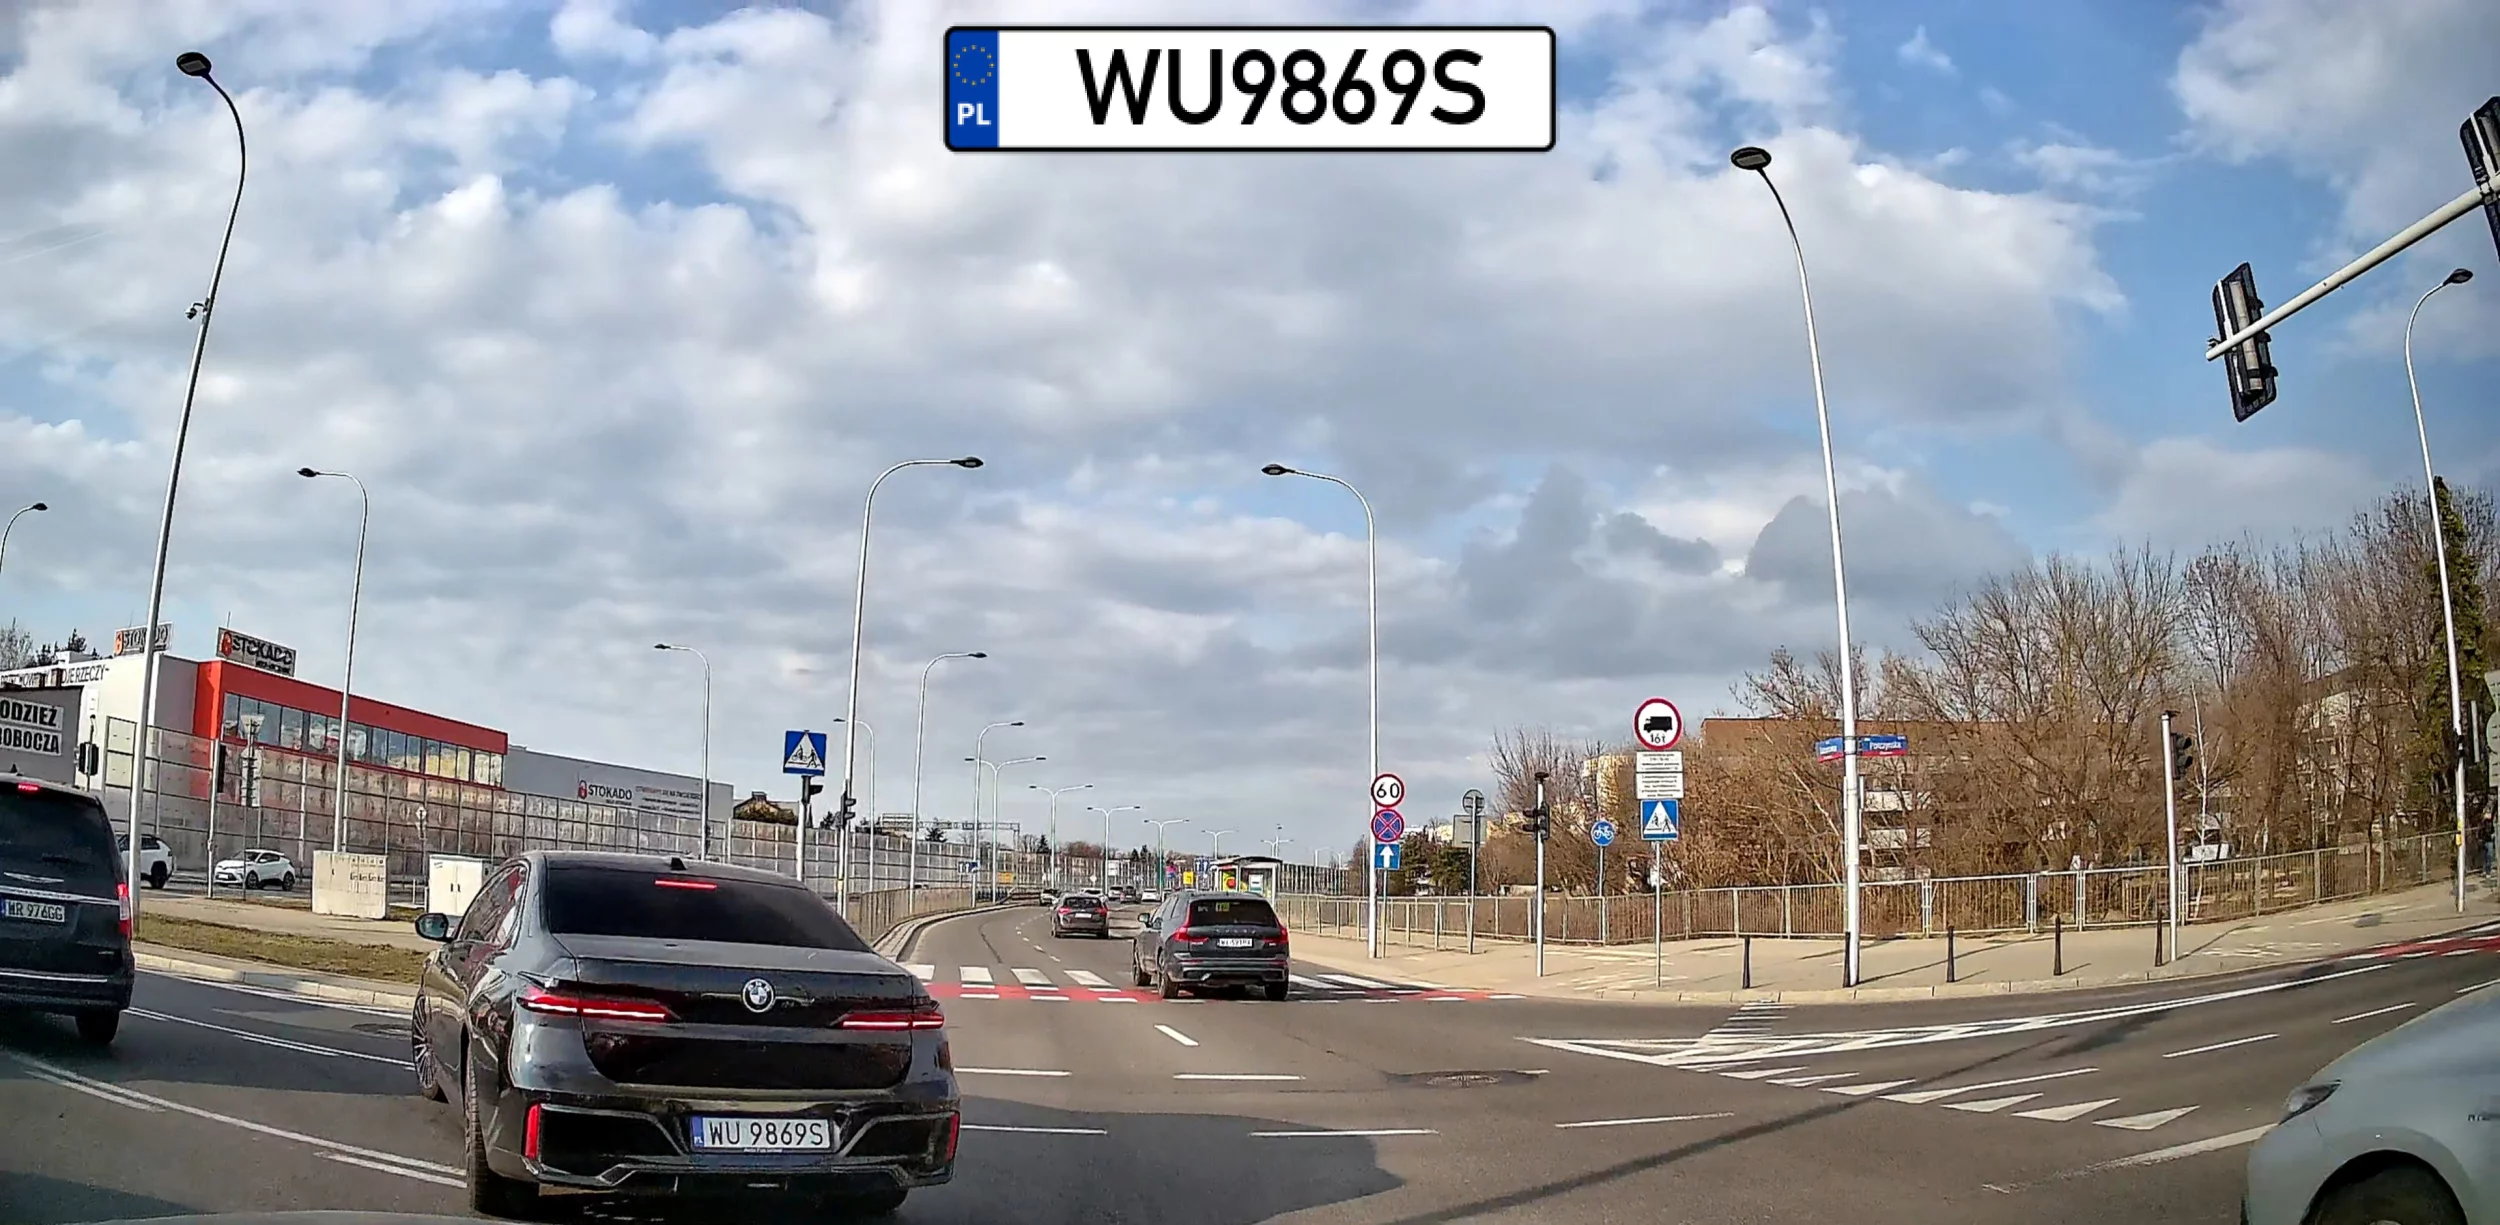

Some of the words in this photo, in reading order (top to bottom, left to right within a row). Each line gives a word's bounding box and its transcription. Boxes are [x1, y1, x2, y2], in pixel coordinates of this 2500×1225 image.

[232, 636, 293, 664] STOKADO
[1650, 733, 1665, 743] 16t
[588, 784, 632, 800] STOKADO
[1377, 782, 1400, 798] 60
[709, 1121, 740, 1145] WU
[750, 1122, 823, 1146] 9869S
